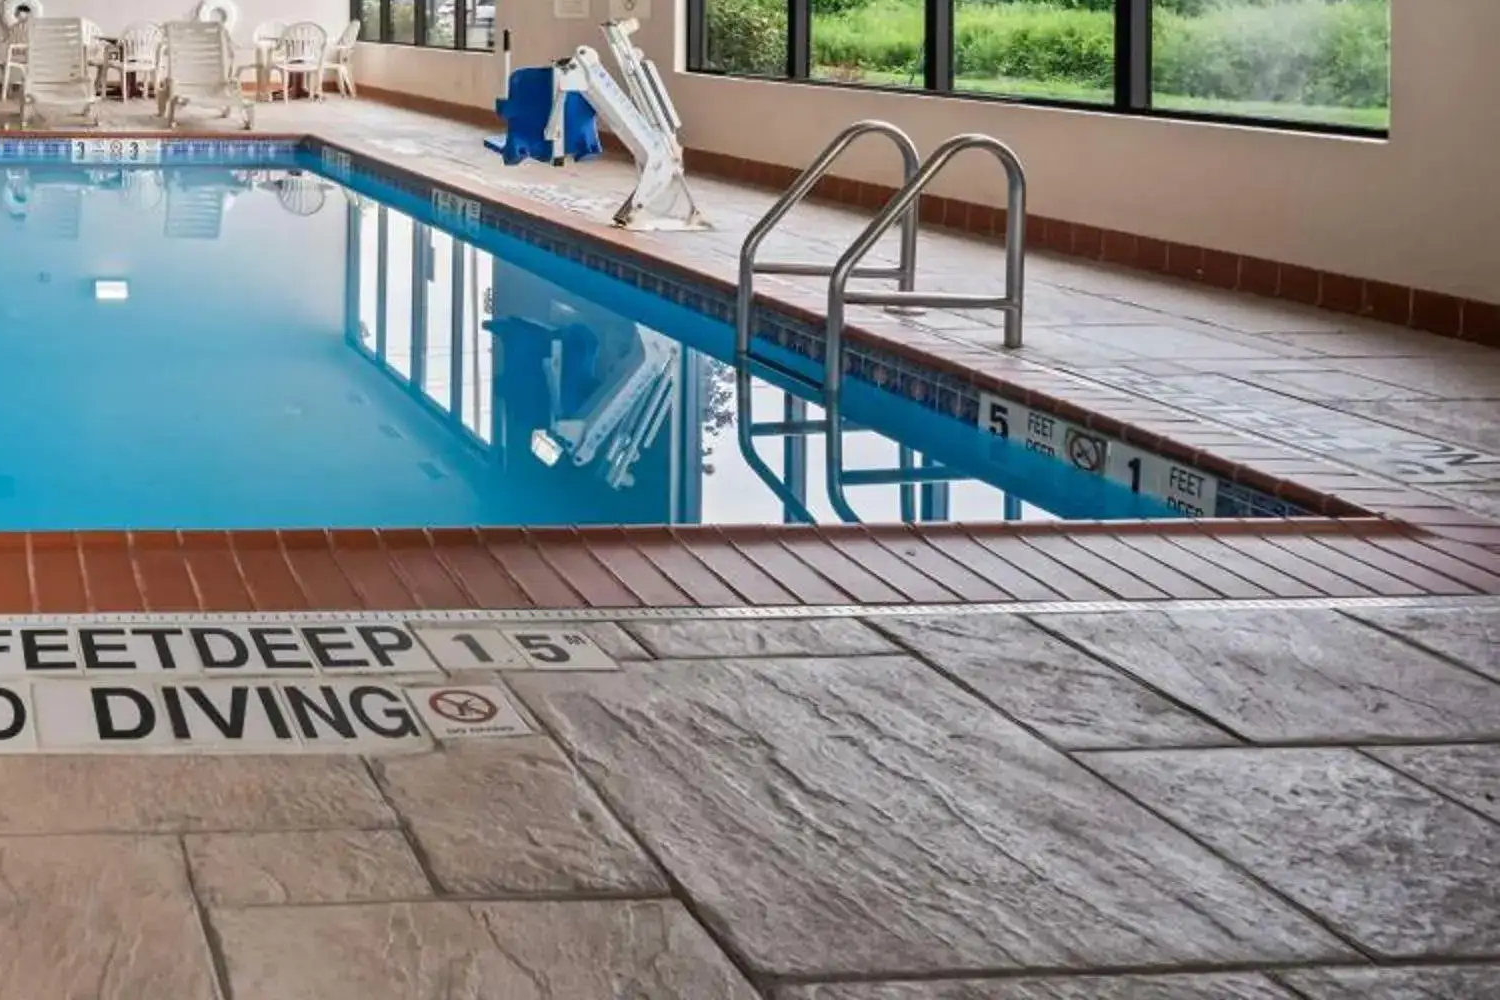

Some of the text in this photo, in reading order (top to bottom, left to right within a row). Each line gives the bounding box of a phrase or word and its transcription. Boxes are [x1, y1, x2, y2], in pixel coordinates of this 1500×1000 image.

[989, 403, 1205, 500] 5 FEET 1 FEET
[94, 686, 420, 740] DIVING
